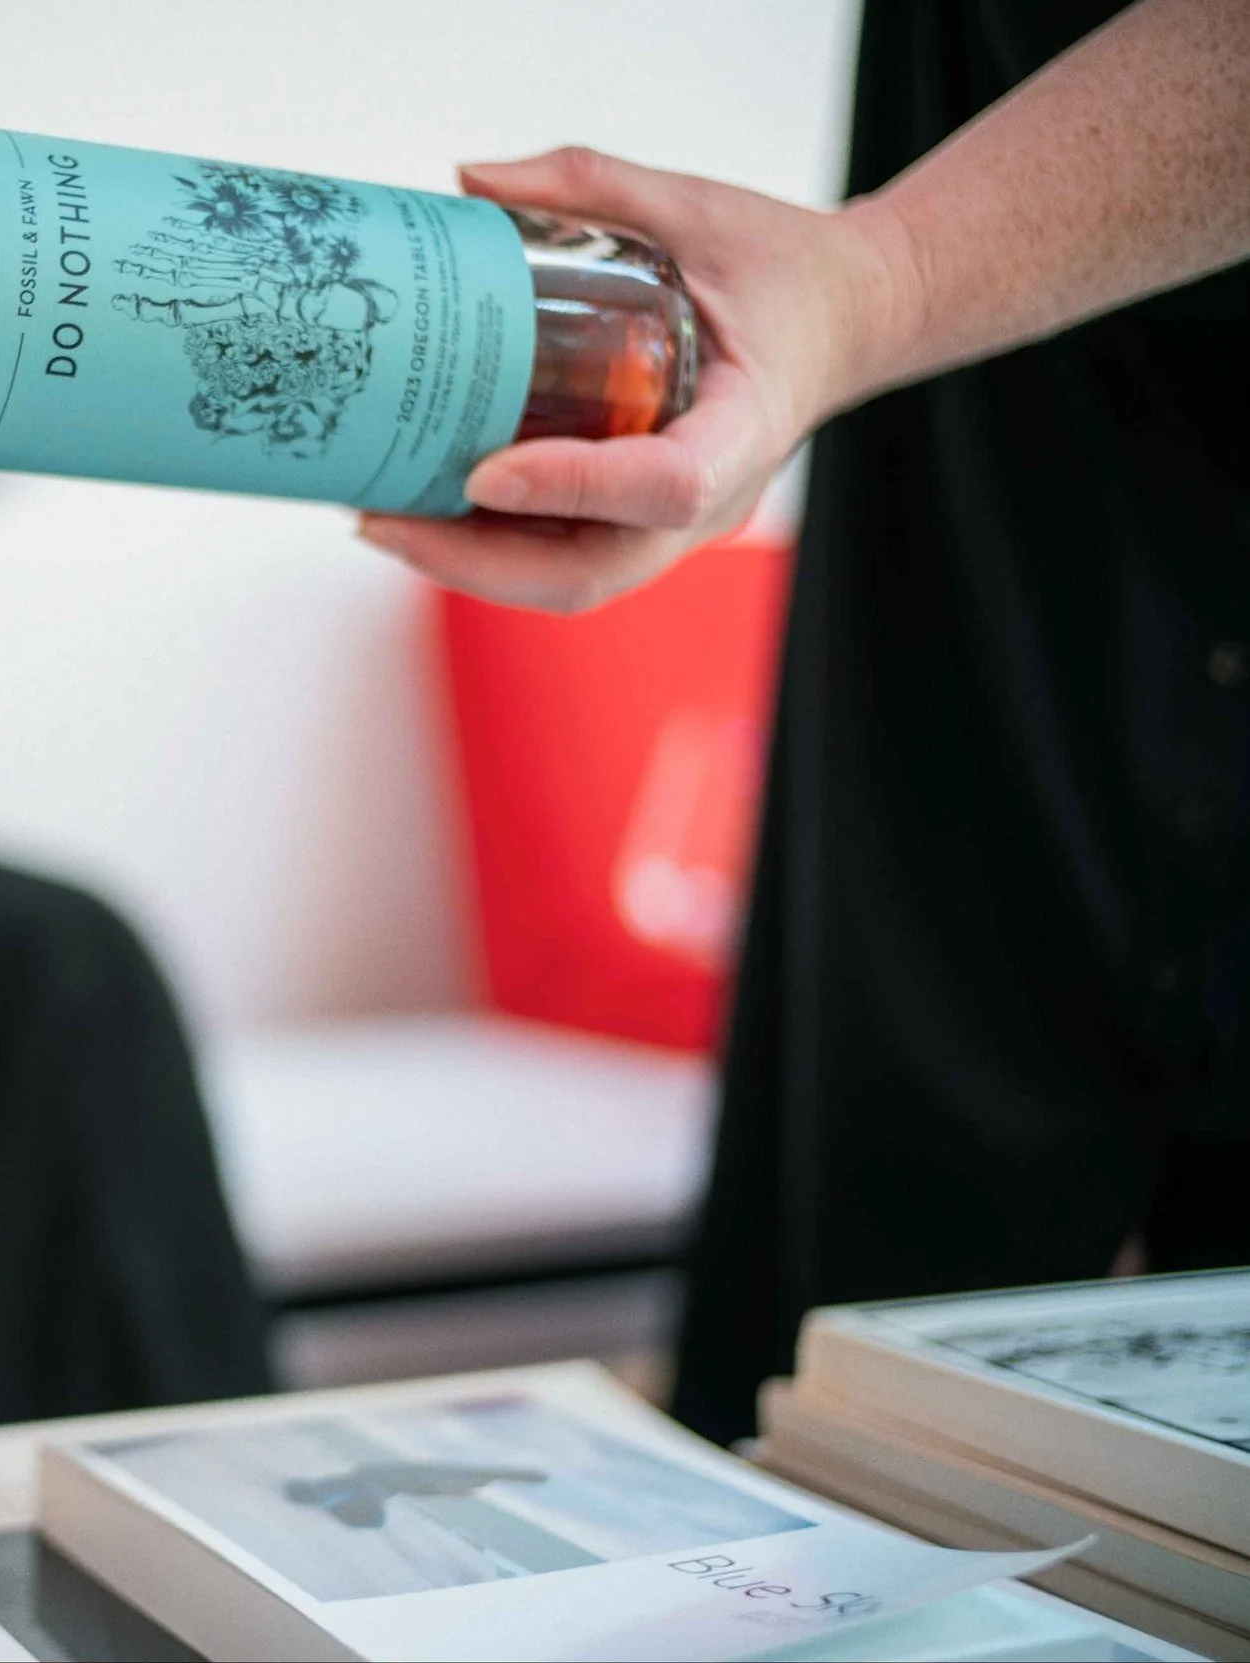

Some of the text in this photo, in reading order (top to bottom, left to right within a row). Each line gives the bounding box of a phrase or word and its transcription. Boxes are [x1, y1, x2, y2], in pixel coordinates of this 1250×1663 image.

[18, 179, 37, 318] FOSSIL & FAWN
[45, 154, 91, 378] DO NOTHING
[406, 234, 429, 282] TABLE
[411, 288, 430, 373] OREGON
[397, 376, 421, 423] 2023
[667, 1554, 792, 1599] Blue
